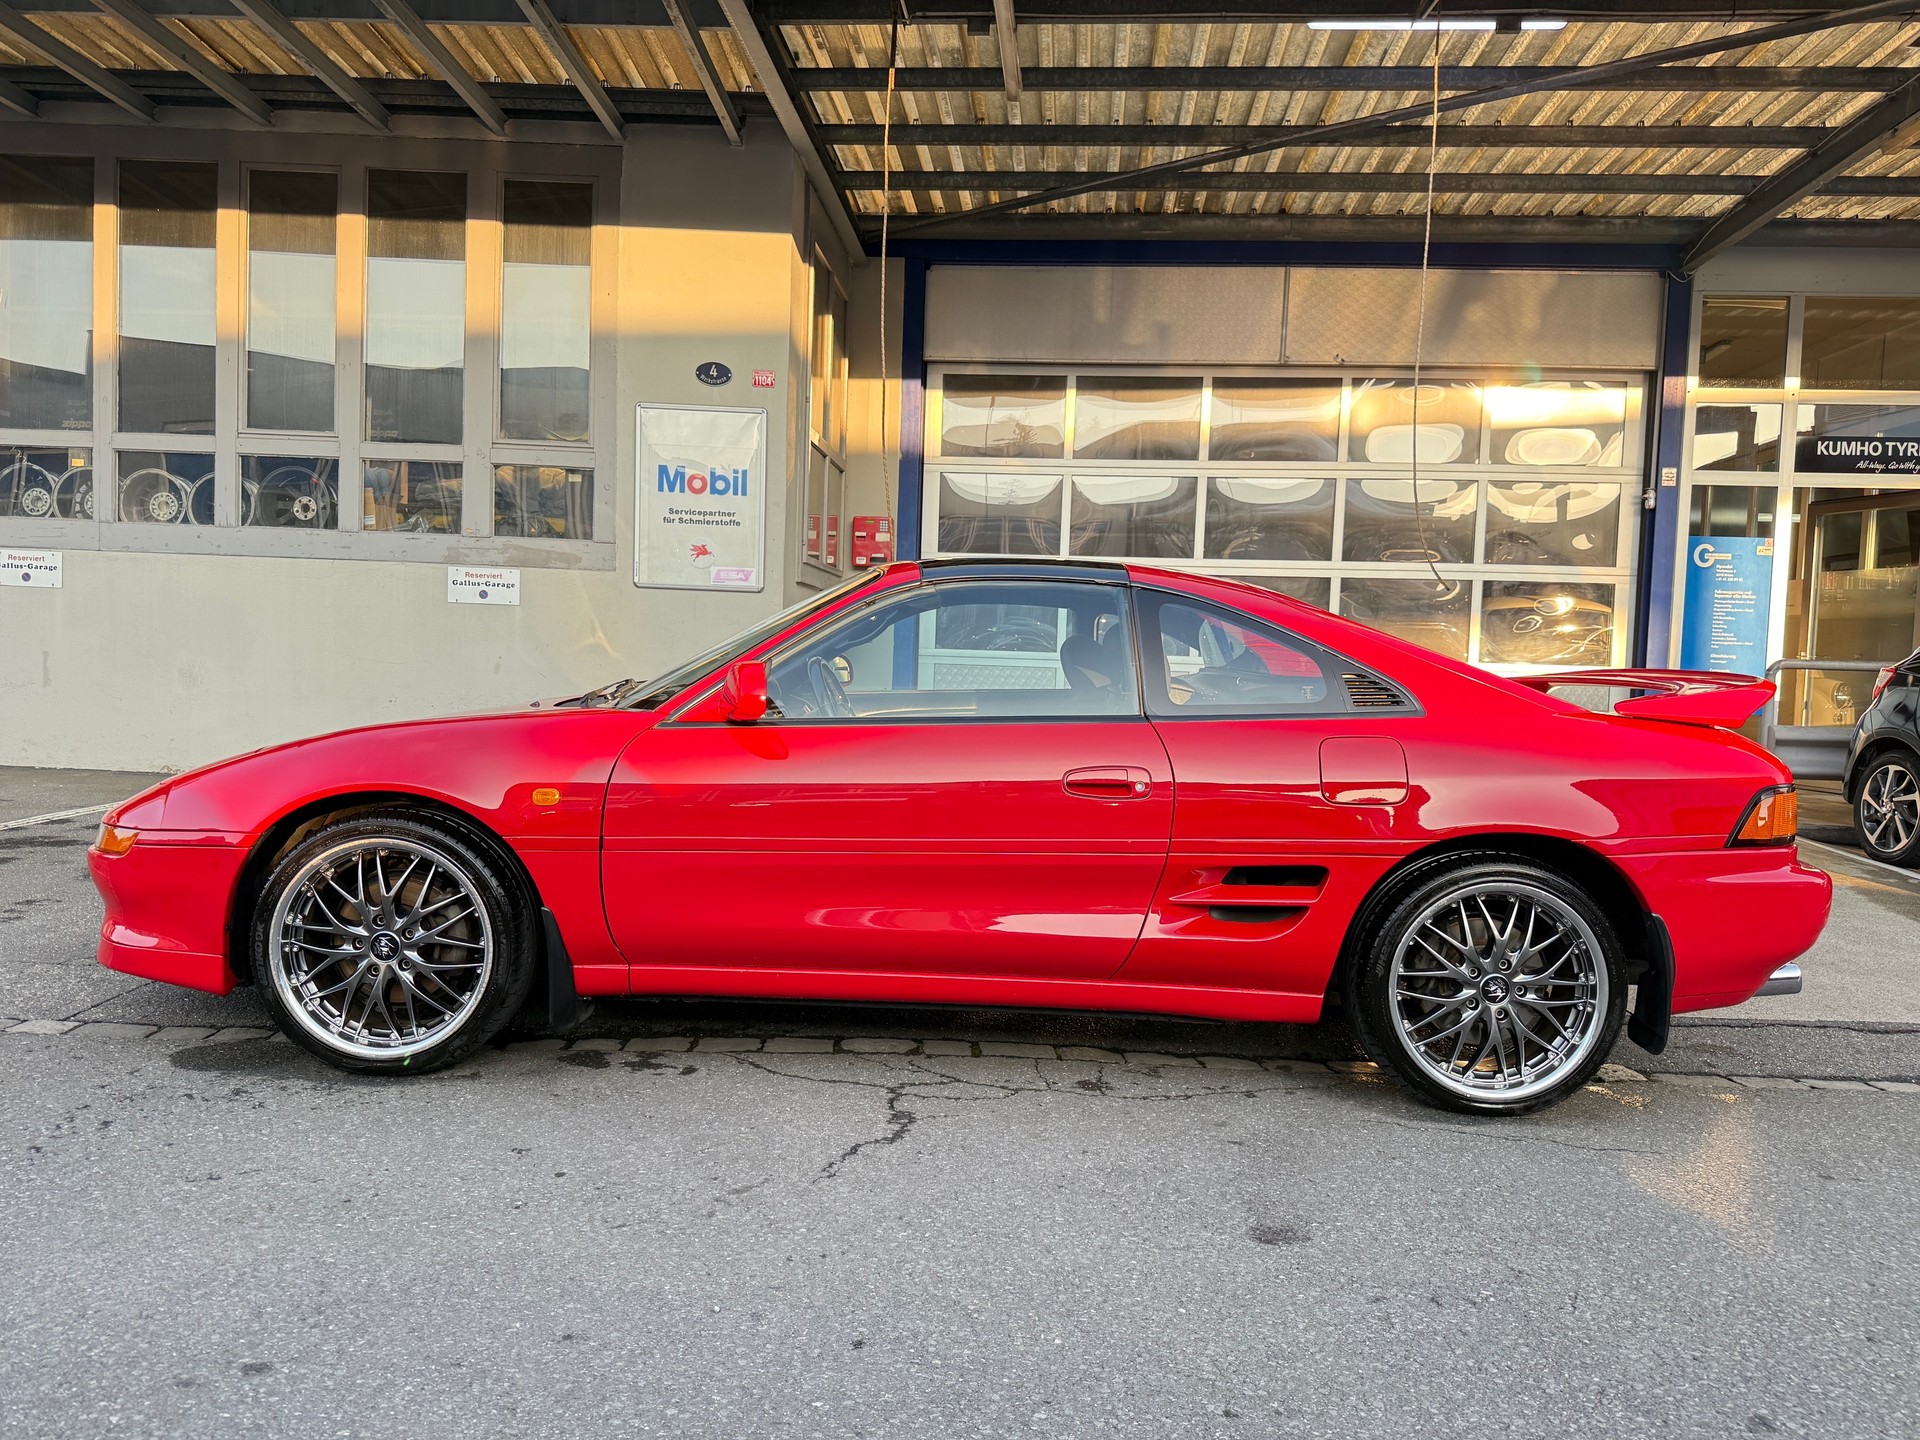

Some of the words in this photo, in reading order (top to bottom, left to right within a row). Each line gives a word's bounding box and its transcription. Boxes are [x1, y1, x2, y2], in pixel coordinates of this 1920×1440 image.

[710, 364, 718, 378] 4
[754, 375, 772, 386] 1104
[1816, 440, 1883, 456] KUMHO
[1885, 441, 1920, 457] TYR
[1888, 461, 1899, 470] Go
[1899, 460, 1915, 470] with
[657, 464, 748, 496] Mobil
[668, 507, 737, 518] Servicepartner
[662, 516, 676, 524] für
[678, 517, 741, 527] Schmierstoffe
[8, 554, 45, 562] Reserviert
[0, 562, 58, 572] allus-Garage
[464, 571, 503, 580] Reserviert
[452, 579, 516, 589] Gallus-Garage
